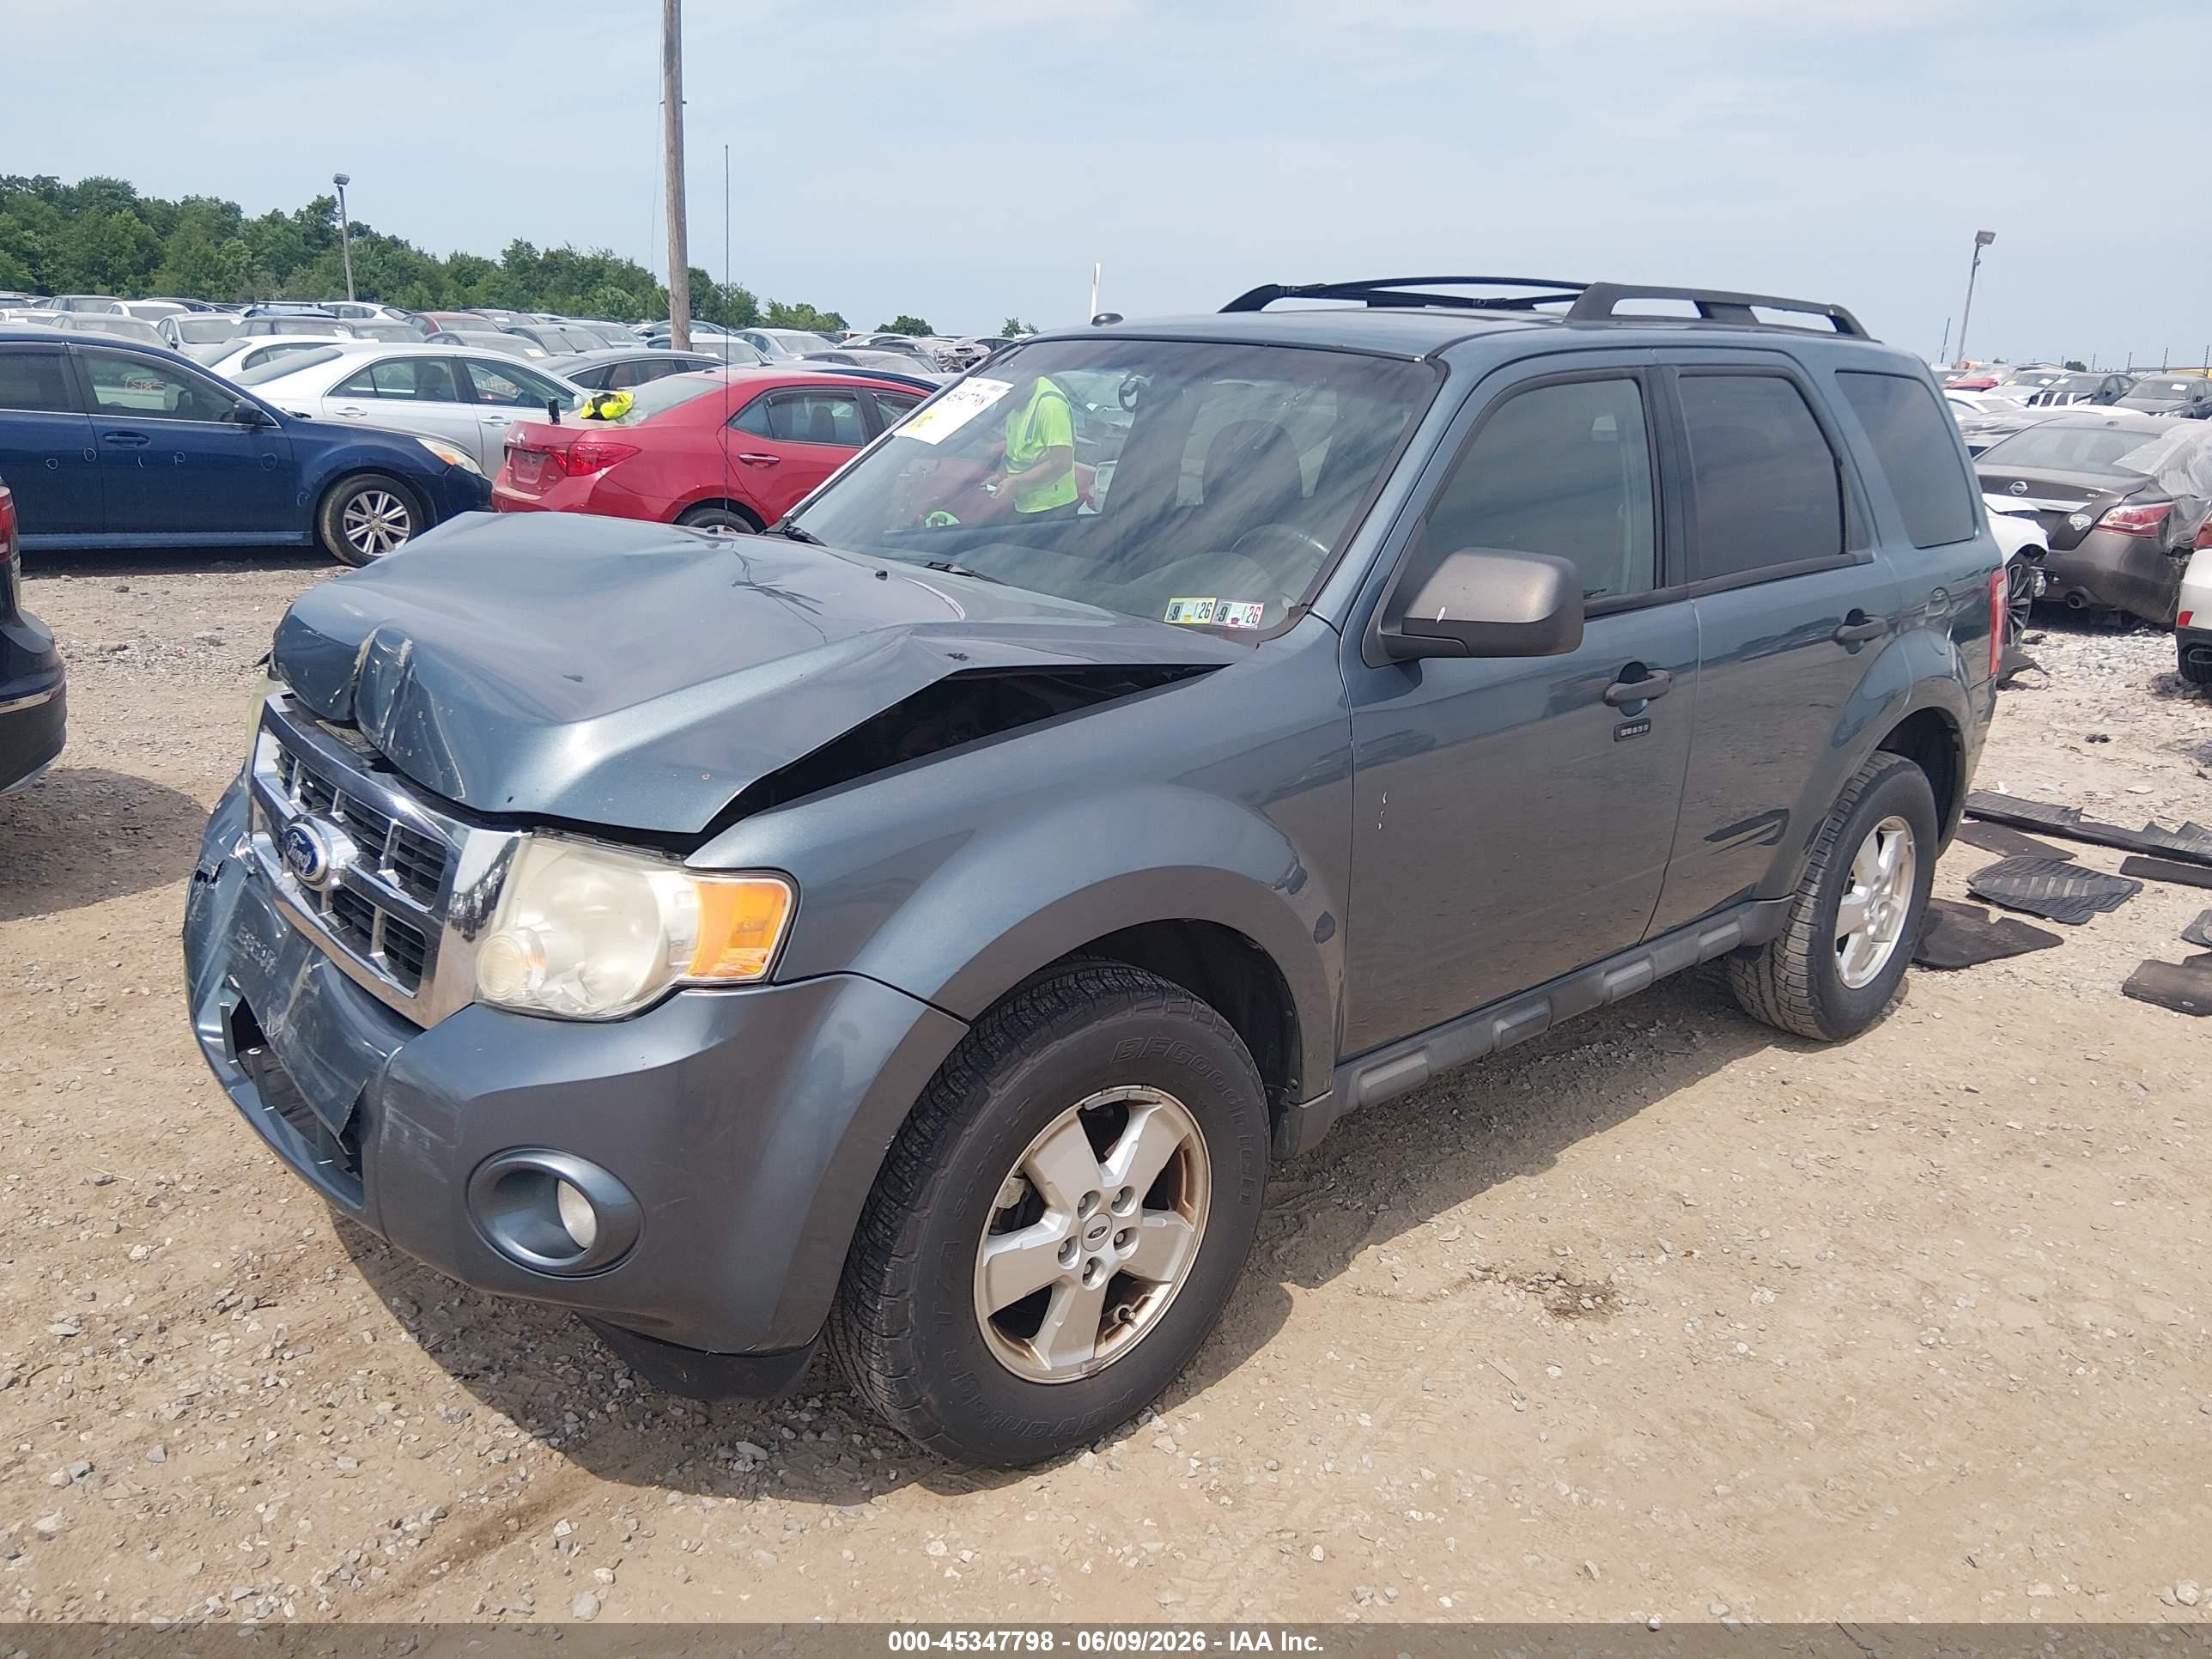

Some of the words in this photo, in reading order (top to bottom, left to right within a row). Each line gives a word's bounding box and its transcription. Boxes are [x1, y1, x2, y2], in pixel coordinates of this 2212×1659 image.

[1171, 605, 1181, 621] 9
[1198, 602, 1212, 619] 26
[1218, 605, 1229, 622] 9
[1245, 605, 1261, 623] 26
[286, 830, 315, 875] Ford
